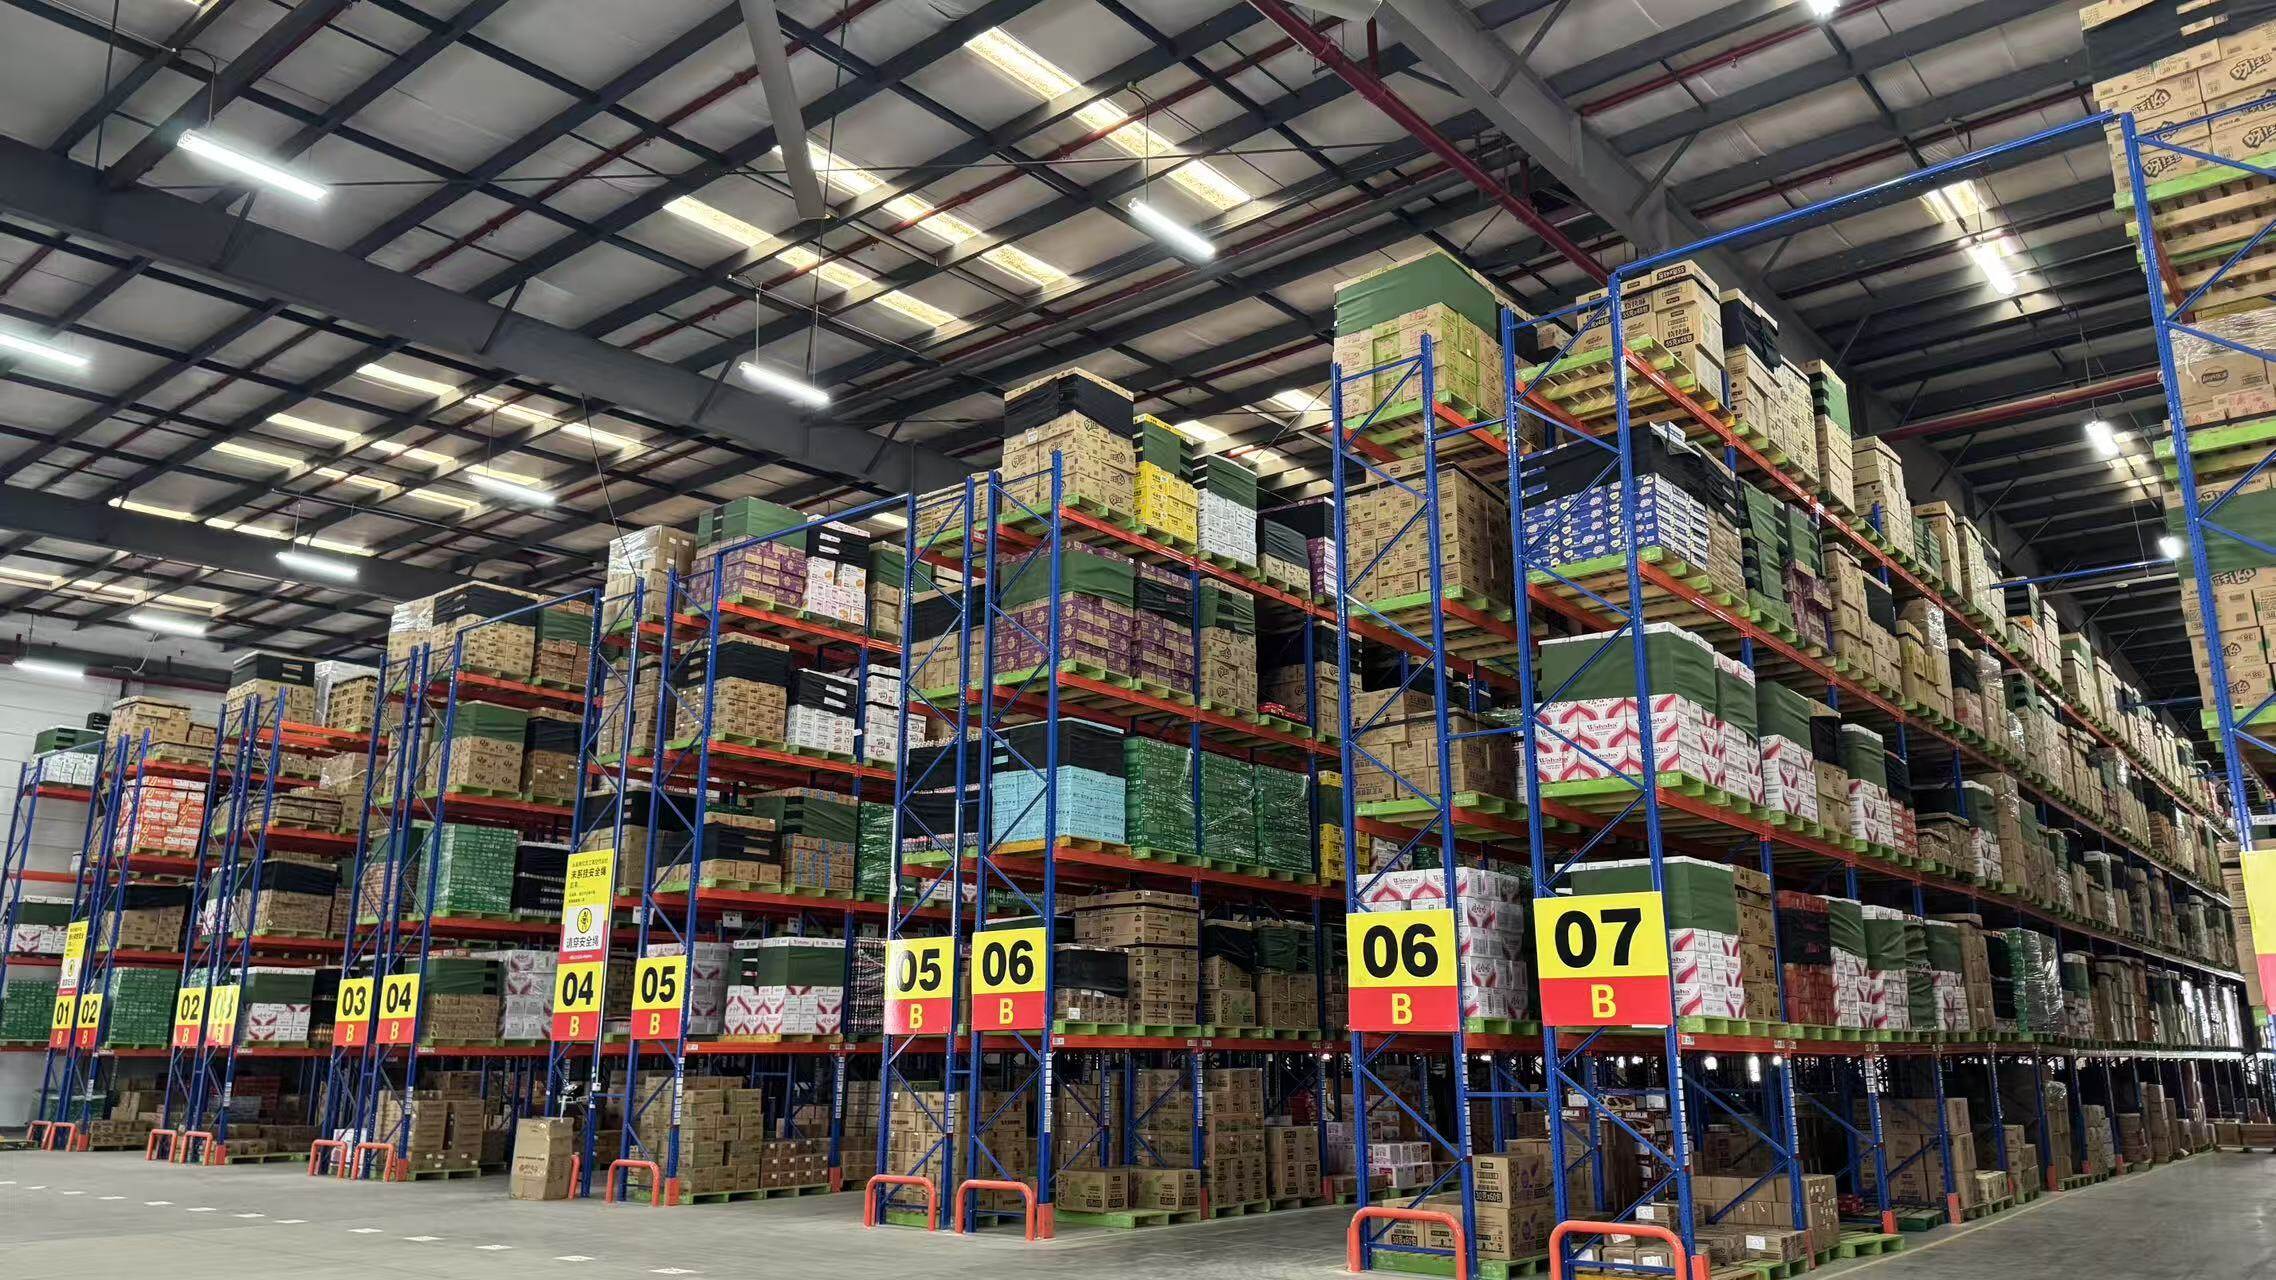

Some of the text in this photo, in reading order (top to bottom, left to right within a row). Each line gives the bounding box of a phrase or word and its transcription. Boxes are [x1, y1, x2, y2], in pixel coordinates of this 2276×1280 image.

[1362, 923, 1439, 979] 06
[1554, 907, 1642, 969] 07
[897, 948, 941, 993] 05
[983, 939, 1034, 986] 06
[387, 982, 411, 1013] 04
[562, 971, 593, 1006] 04
[641, 966, 675, 1004] 05
[55, 1002, 70, 1025] 01
[81, 1001, 97, 1024] 02
[181, 994, 200, 1021] 02
[343, 986, 365, 1017] 03
[999, 998, 1014, 1025] B
[1391, 993, 1413, 1025] B
[1591, 984, 1617, 1018] B
[390, 1021, 399, 1041] B
[570, 1016, 579, 1036] B
[650, 1013, 661, 1036] B
[909, 1003, 923, 1030] B
[182, 1027, 190, 1044] B
[346, 1023, 355, 1043] B
